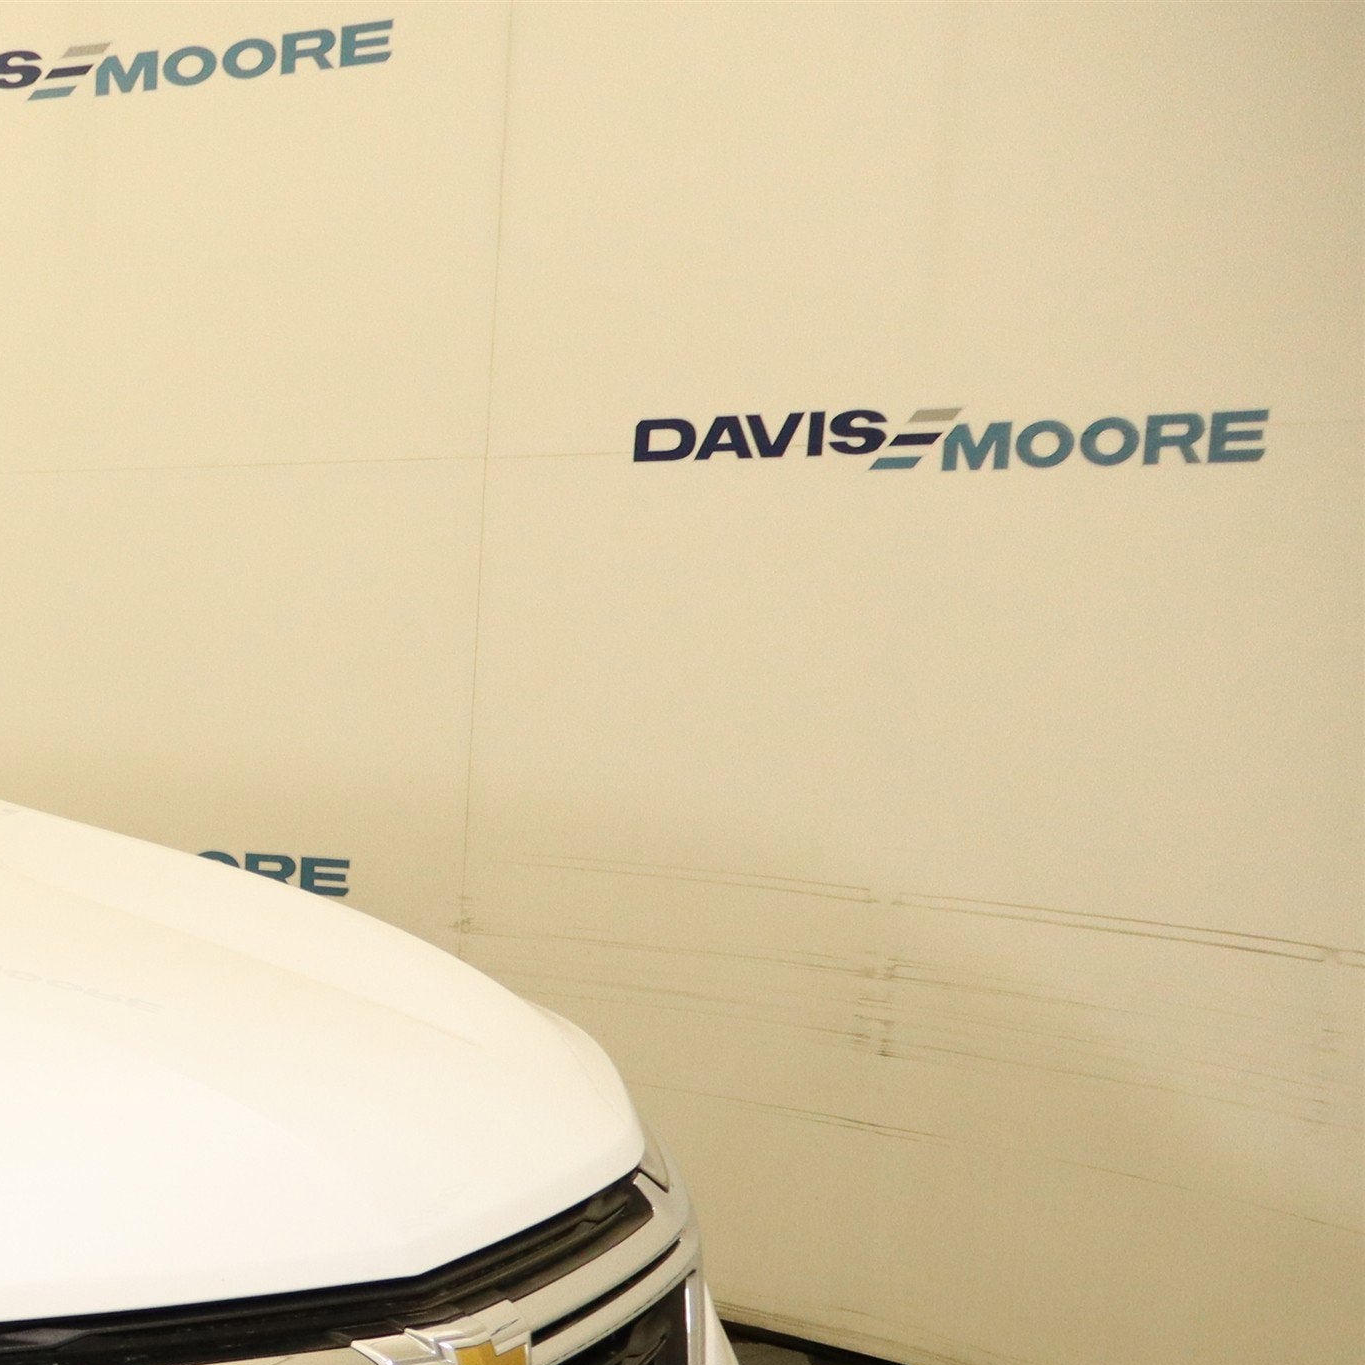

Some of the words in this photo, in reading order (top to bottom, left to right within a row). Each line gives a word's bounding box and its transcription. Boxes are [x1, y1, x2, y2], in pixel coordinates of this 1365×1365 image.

[95, 19, 394, 97] MOORE
[632, 408, 888, 463] DAVIS
[941, 408, 1270, 472] MOORE
